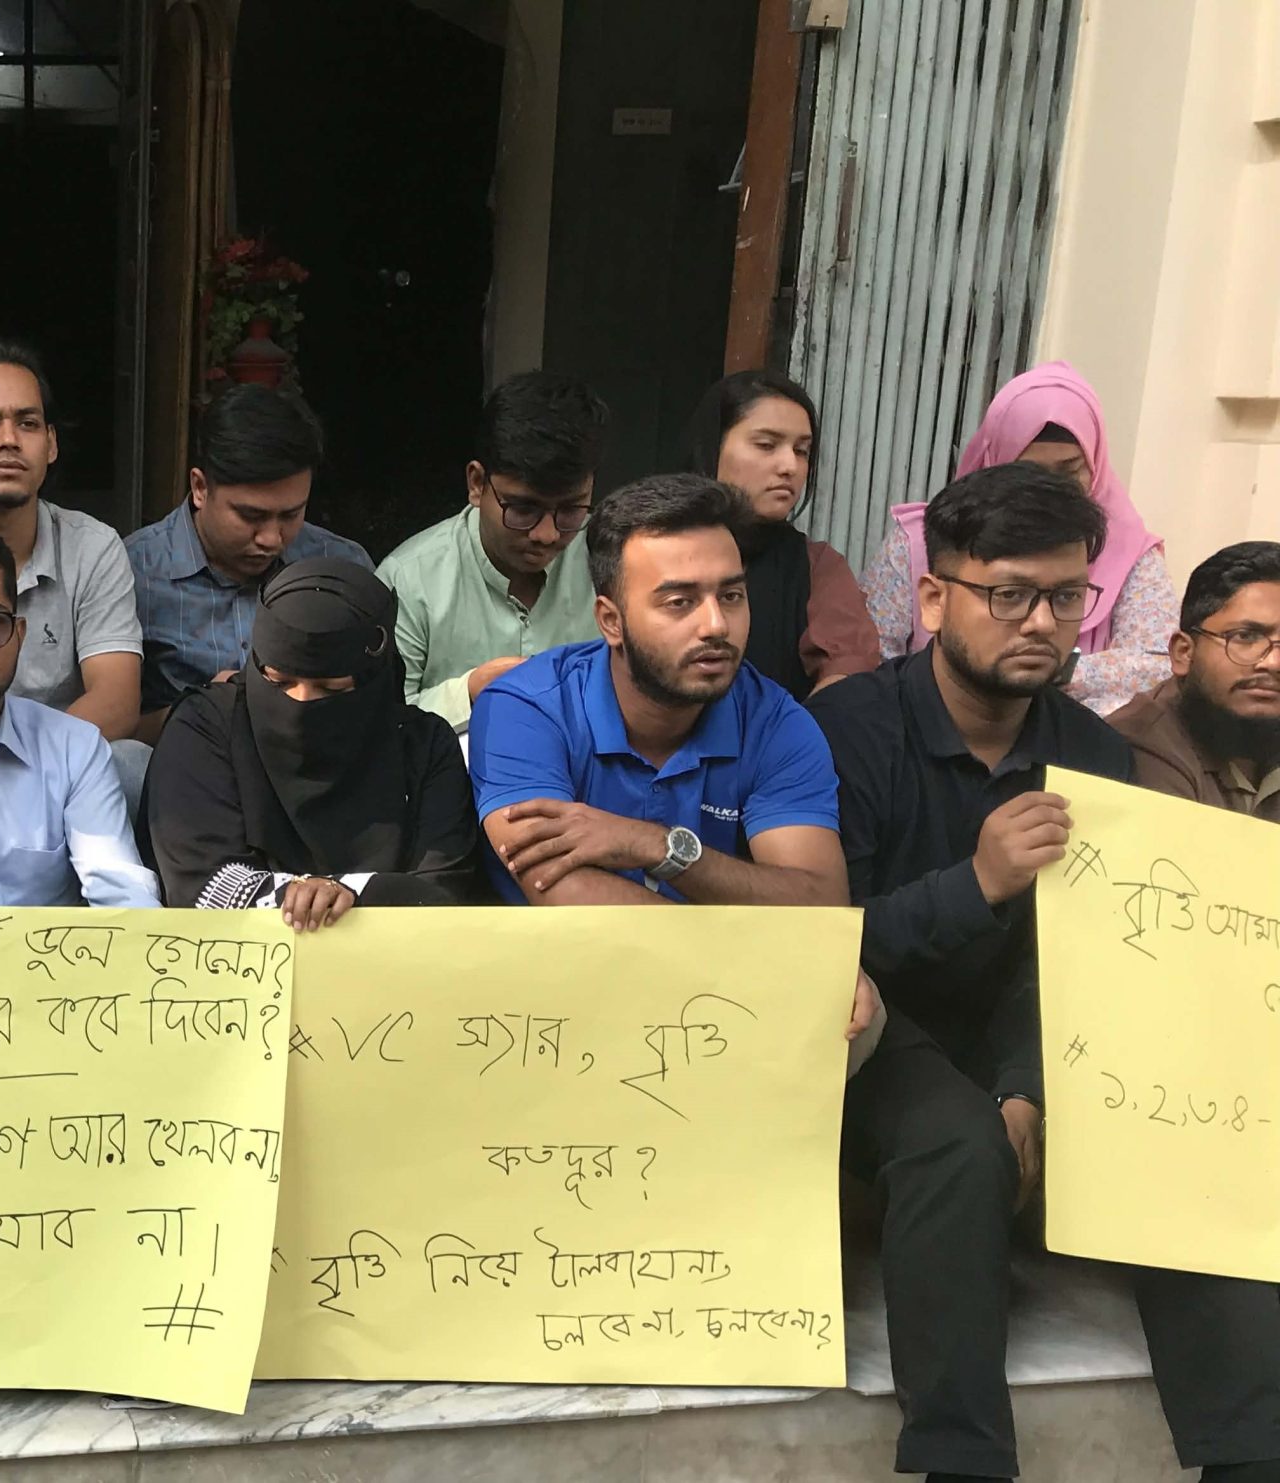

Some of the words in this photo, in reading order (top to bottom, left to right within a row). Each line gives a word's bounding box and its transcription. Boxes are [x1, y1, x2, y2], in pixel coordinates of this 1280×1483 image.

[1112, 858, 1199, 960] বৃত্তি
[1207, 905, 1280, 948] আমা
[36, 993, 131, 1053] কবে
[331, 1011, 413, 1062] VC
[619, 994, 758, 1120] বৃত্তি
[49, 1113, 125, 1168] আর
[310, 1230, 402, 1317] বৃত্তি
[424, 1233, 523, 1293] নিয়ে
